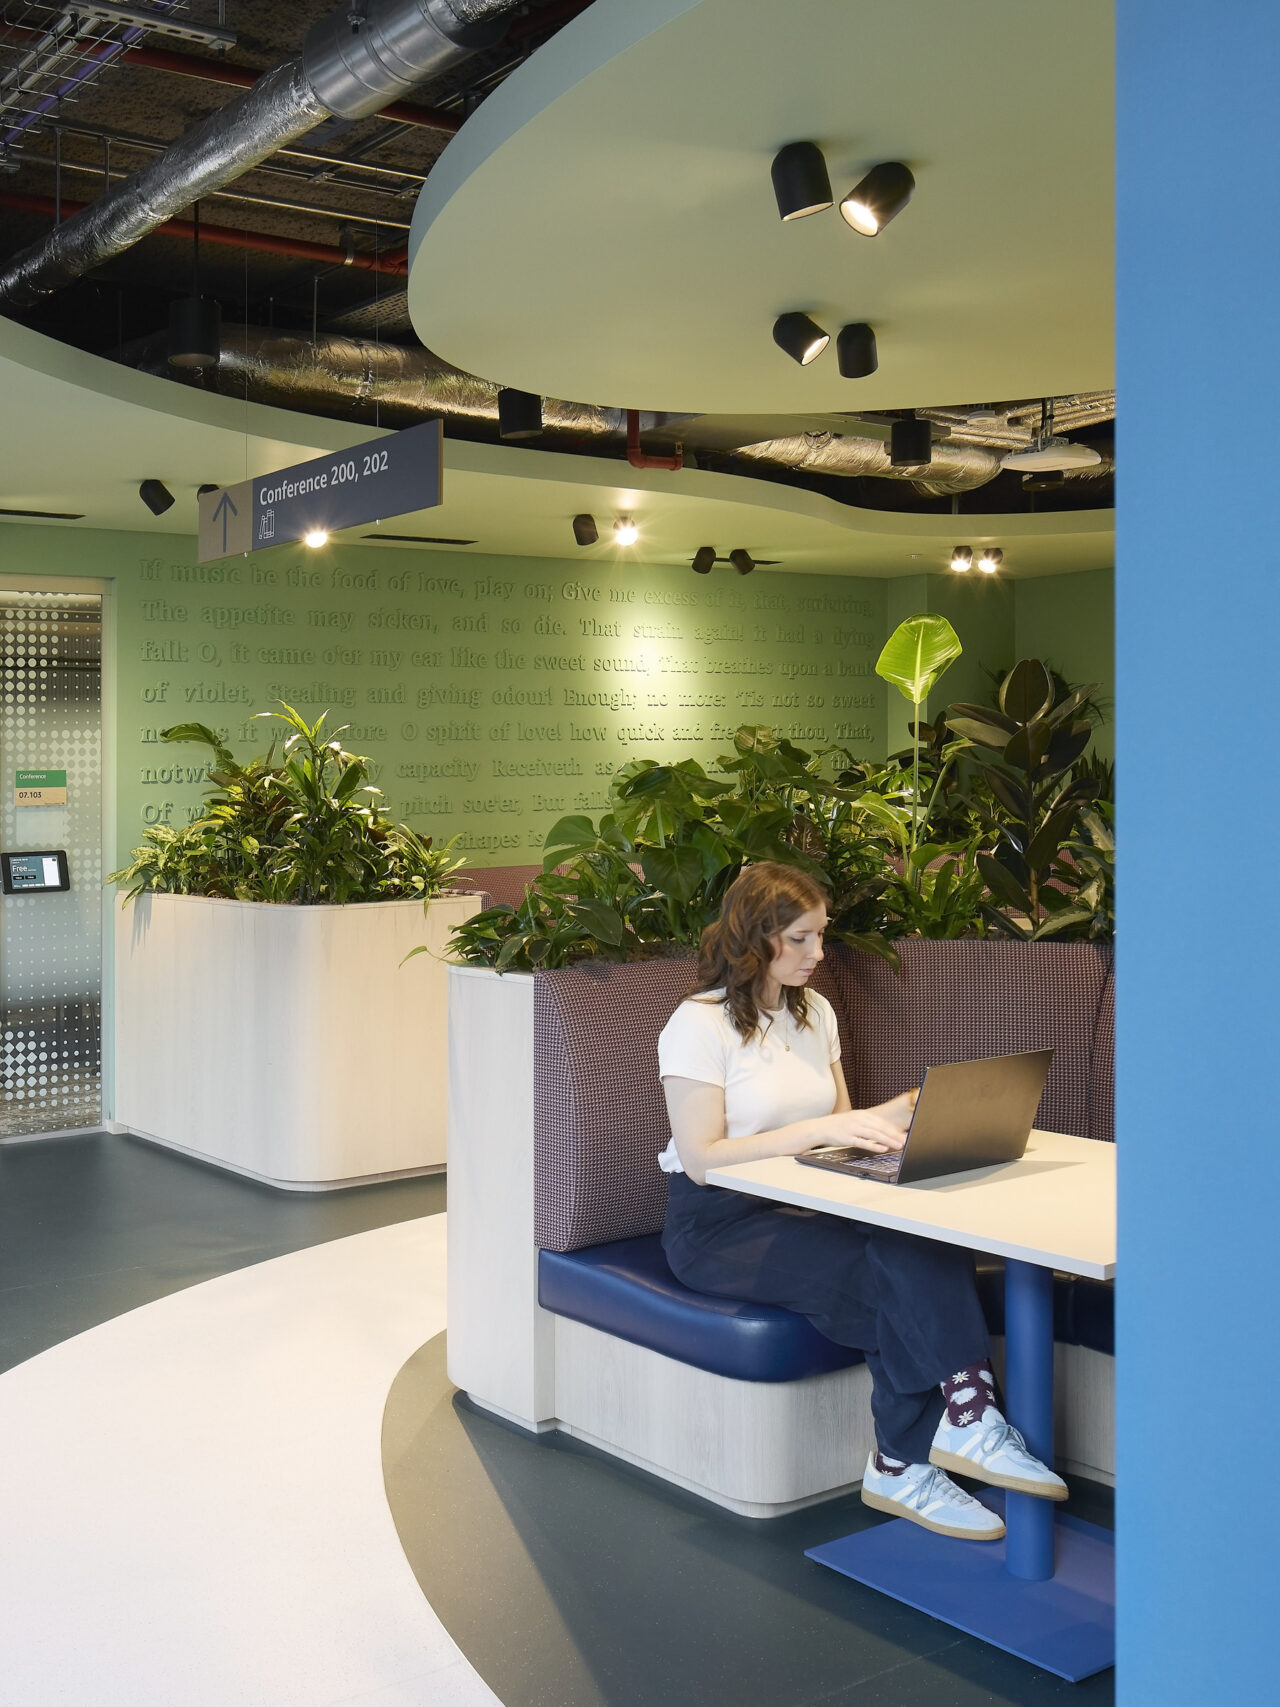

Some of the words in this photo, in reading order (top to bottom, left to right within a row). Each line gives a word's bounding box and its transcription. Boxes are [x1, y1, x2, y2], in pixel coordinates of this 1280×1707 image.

[260, 473, 327, 505] Conference
[331, 460, 359, 486] 200,
[363, 450, 389, 476] 202
[138, 559, 164, 583] If
[171, 560, 241, 584] music
[250, 563, 278, 585] be
[287, 565, 321, 588] the
[331, 568, 378, 590] food
[388, 570, 411, 593] of
[418, 572, 465, 598] love,
[474, 576, 515, 600] play
[524, 582, 554, 602] on;
[562, 580, 601, 601] Give
[609, 587, 636, 604] me
[644, 587, 697, 606] excess
[140, 599, 187, 622] The
[201, 602, 295, 629] appetite
[309, 609, 355, 631] may
[368, 608, 439, 633] sicken,
[452, 612, 488, 633] and
[501, 617, 521, 633] so
[534, 614, 567, 636] die.
[579, 617, 621, 638] That
[633, 621, 683, 640] strain
[752, 625, 767, 642] it
[775, 625, 804, 643] had
[814, 630, 823, 644] a
[140, 639, 188, 663] fall:
[198, 640, 222, 667] O,
[231, 640, 249, 664] it
[258, 648, 315, 665] came
[323, 644, 362, 665] o'er
[371, 650, 402, 671] my
[411, 651, 443, 668] ear
[450, 647, 489, 669] like
[495, 648, 528, 670] the
[534, 653, 586, 672] sweet
[704, 655, 773, 675] breathes
[779, 659, 817, 680] upon
[823, 663, 833, 676] a
[139, 680, 169, 704] of
[184, 680, 255, 707] violet,
[266, 681, 357, 708] Stealing
[368, 682, 407, 704] and
[417, 683, 482, 709] giving
[492, 684, 553, 706] odour!
[564, 686, 637, 711] Enough;
[646, 692, 669, 707] no
[772, 690, 800, 707] not
[807, 693, 825, 708] so
[831, 692, 876, 709] sweet
[239, 722, 258, 743] it
[321, 721, 387, 741] before
[401, 721, 419, 741] O
[427, 720, 481, 745] spirit
[488, 721, 513, 741] of
[518, 719, 562, 741] love!
[570, 721, 607, 741] how
[617, 722, 665, 745] quick
[672, 722, 703, 741] and
[789, 723, 828, 743] thou,
[835, 722, 875, 743] That,
[396, 758, 481, 782] capacity
[492, 758, 584, 777] Receiveth
[595, 762, 613, 775] as
[140, 801, 173, 825] Of
[400, 794, 454, 820] pitch
[463, 795, 522, 817] soe'er,
[530, 793, 565, 812] But
[574, 791, 613, 810] falls
[455, 830, 520, 854] shapes
[528, 829, 544, 848] is
